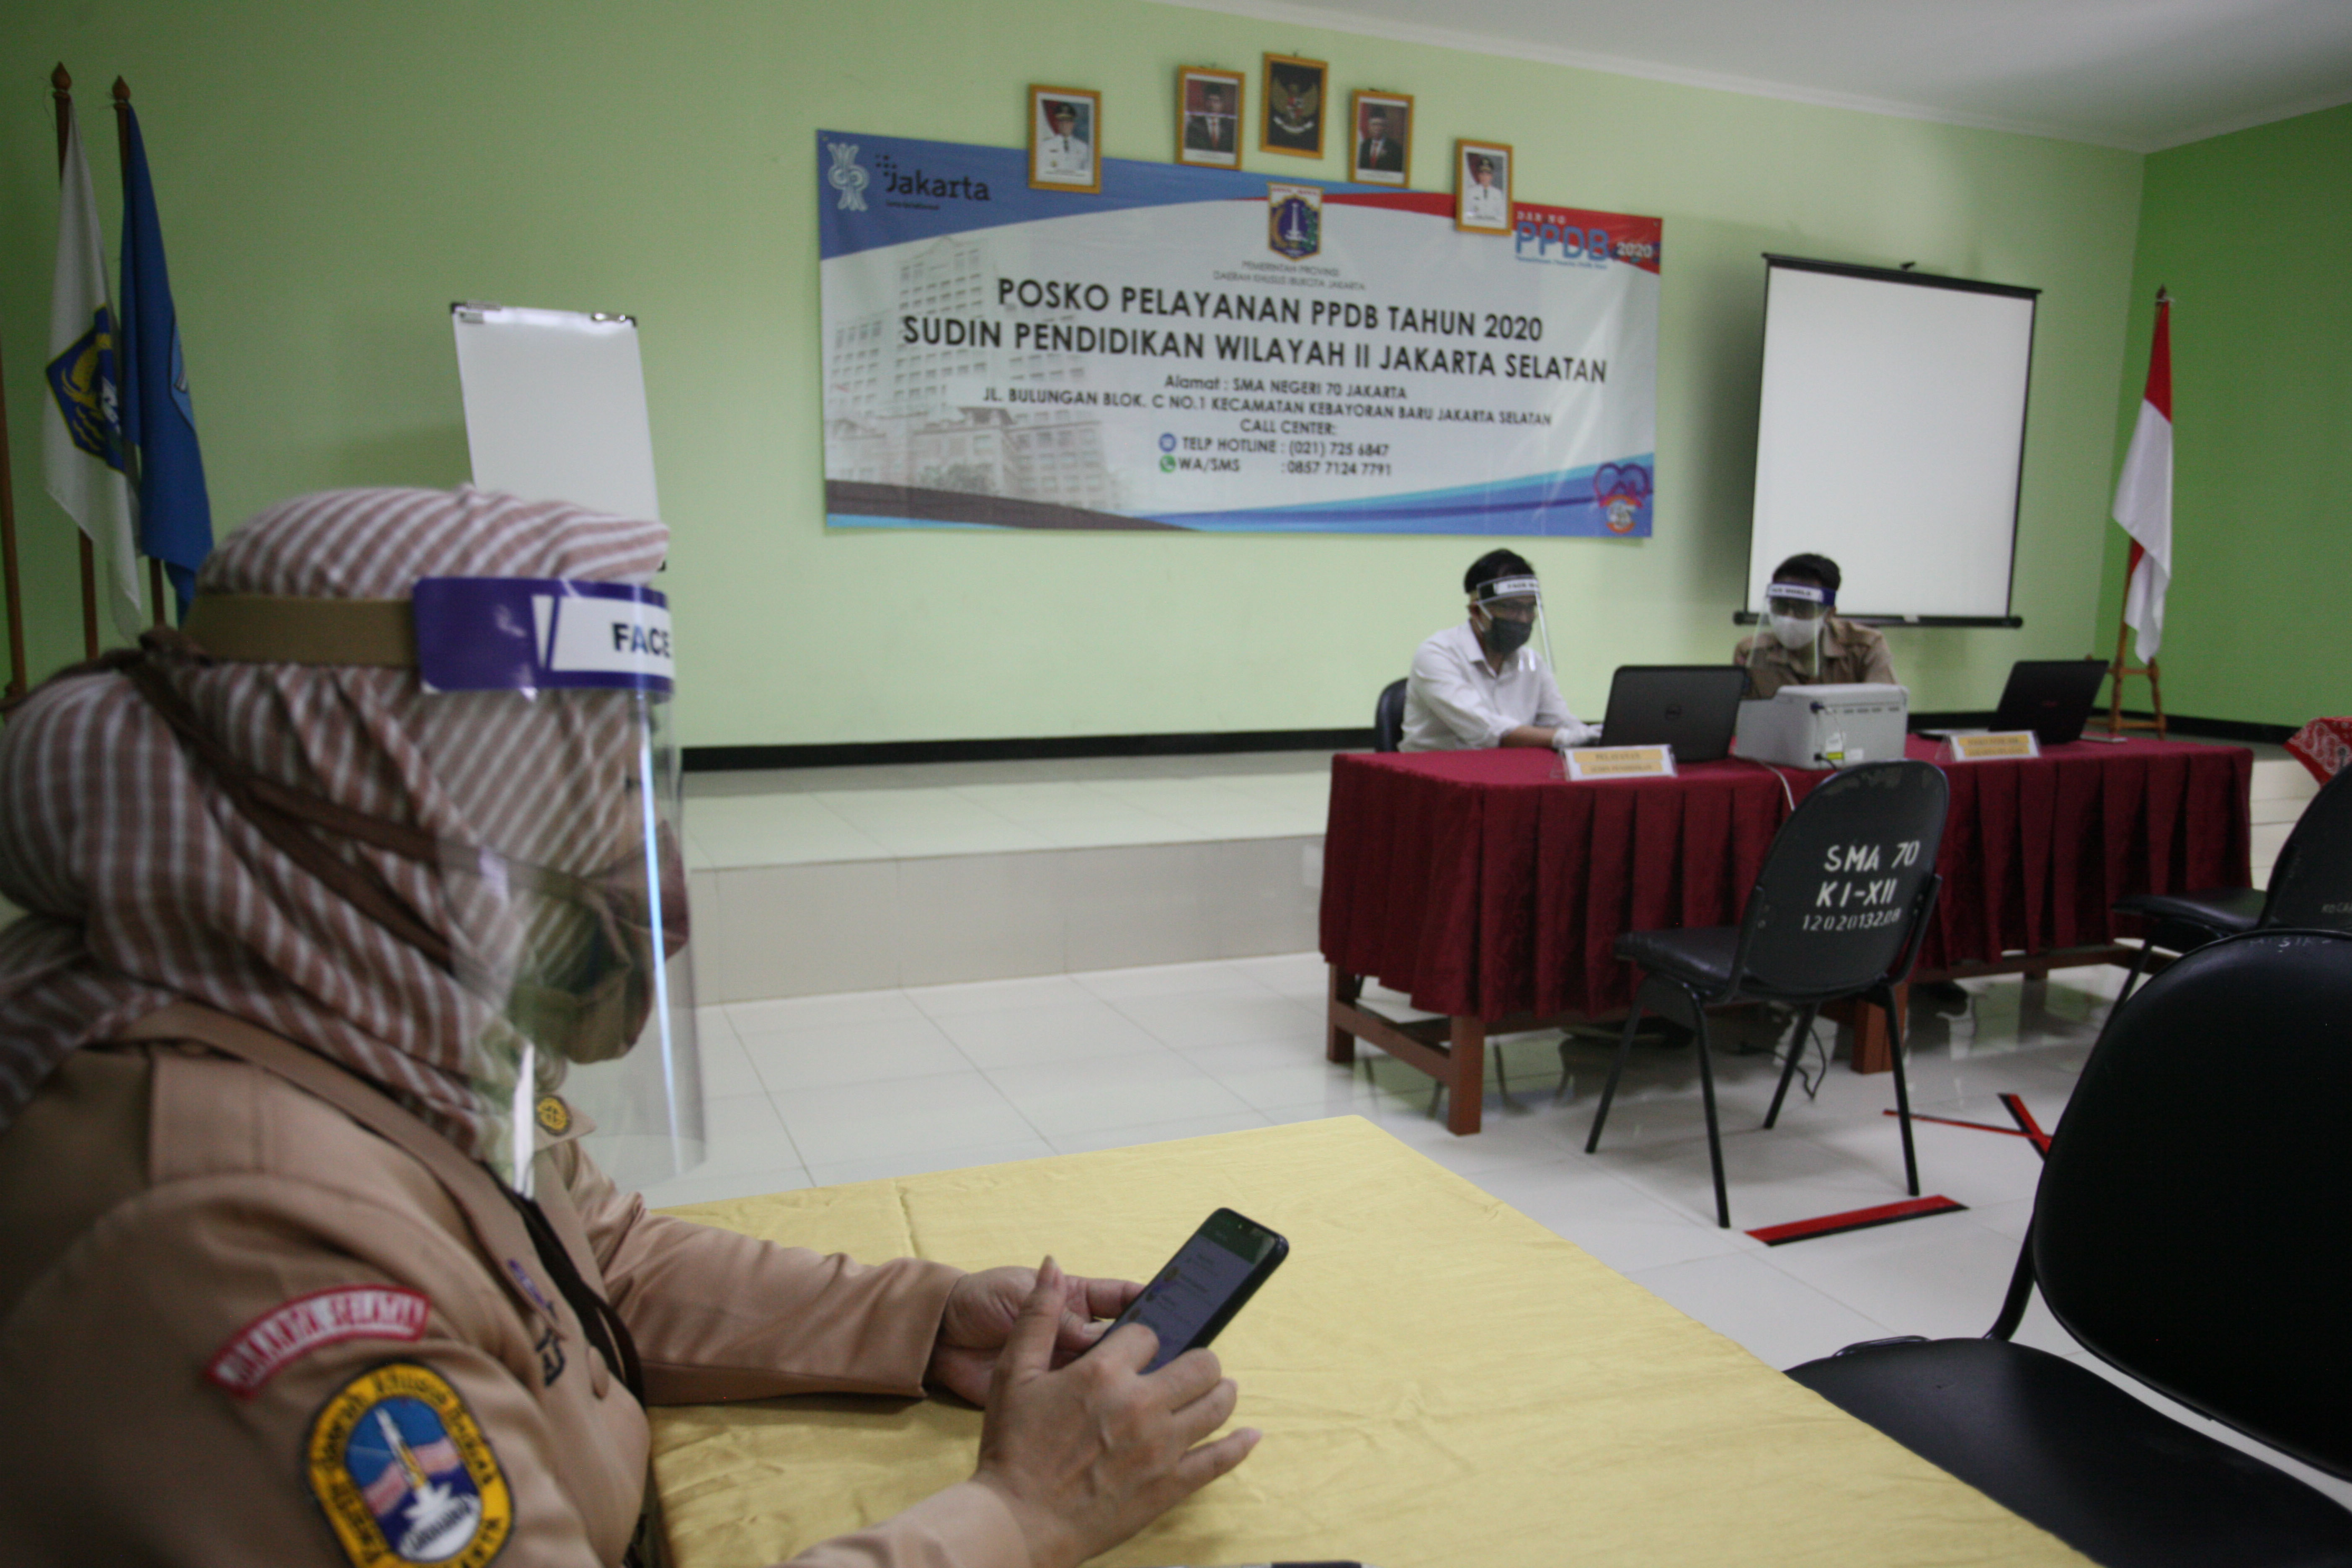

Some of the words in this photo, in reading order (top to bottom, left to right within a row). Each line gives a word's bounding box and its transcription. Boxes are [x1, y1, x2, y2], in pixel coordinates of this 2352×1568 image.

[886, 169, 990, 201] Jakarta
[1515, 221, 1609, 261] PPDB
[1616, 242, 1653, 258] 2020
[998, 278, 1109, 311] POSKO
[1122, 286, 1300, 325] PELAYANAN
[1312, 300, 1378, 329] PPDB
[1388, 306, 1475, 336] TAHUN
[1484, 314, 1542, 341] 2020
[903, 316, 1001, 348] SUDIN
[1015, 322, 1204, 359] PENDIDIKAN
[1216, 335, 1344, 367] WILAYAH
[1355, 343, 1369, 369] II
[1379, 345, 1496, 376] JAKARTA
[1505, 353, 1607, 383] SELATAN
[1165, 374, 1220, 390] Alamat
[1233, 378, 1264, 392] SMA
[1270, 380, 1321, 395] NEGERI
[1327, 382, 1341, 396] 70
[1346, 384, 1407, 399] JAKARTA
[983, 387, 1003, 401] JL.
[1008, 388, 1098, 405] BULUNGAN
[1152, 394, 1164, 408] C
[1212, 397, 1304, 414] KECAMATAN
[1309, 402, 1393, 418] KEBAYORAN
[1399, 406, 1432, 420] BARU
[1437, 408, 1494, 423] JAKARTA
[1499, 410, 1552, 426] SELATAN
[1240, 418, 1277, 433] CALL
[1181, 437, 1212, 451] TELP
[1218, 438, 1277, 453] HOTLINE
[1289, 441, 1325, 457] (021)
[1330, 441, 1353, 455] 725
[1358, 444, 1390, 456] 6847
[1179, 457, 1240, 472] WA/SMS
[1325, 461, 1357, 475] 7124
[1362, 462, 1391, 476] 7791
[612, 622, 670, 658] FACE
[1824, 845, 1880, 872] SMA
[1890, 840, 1920, 869] 70
